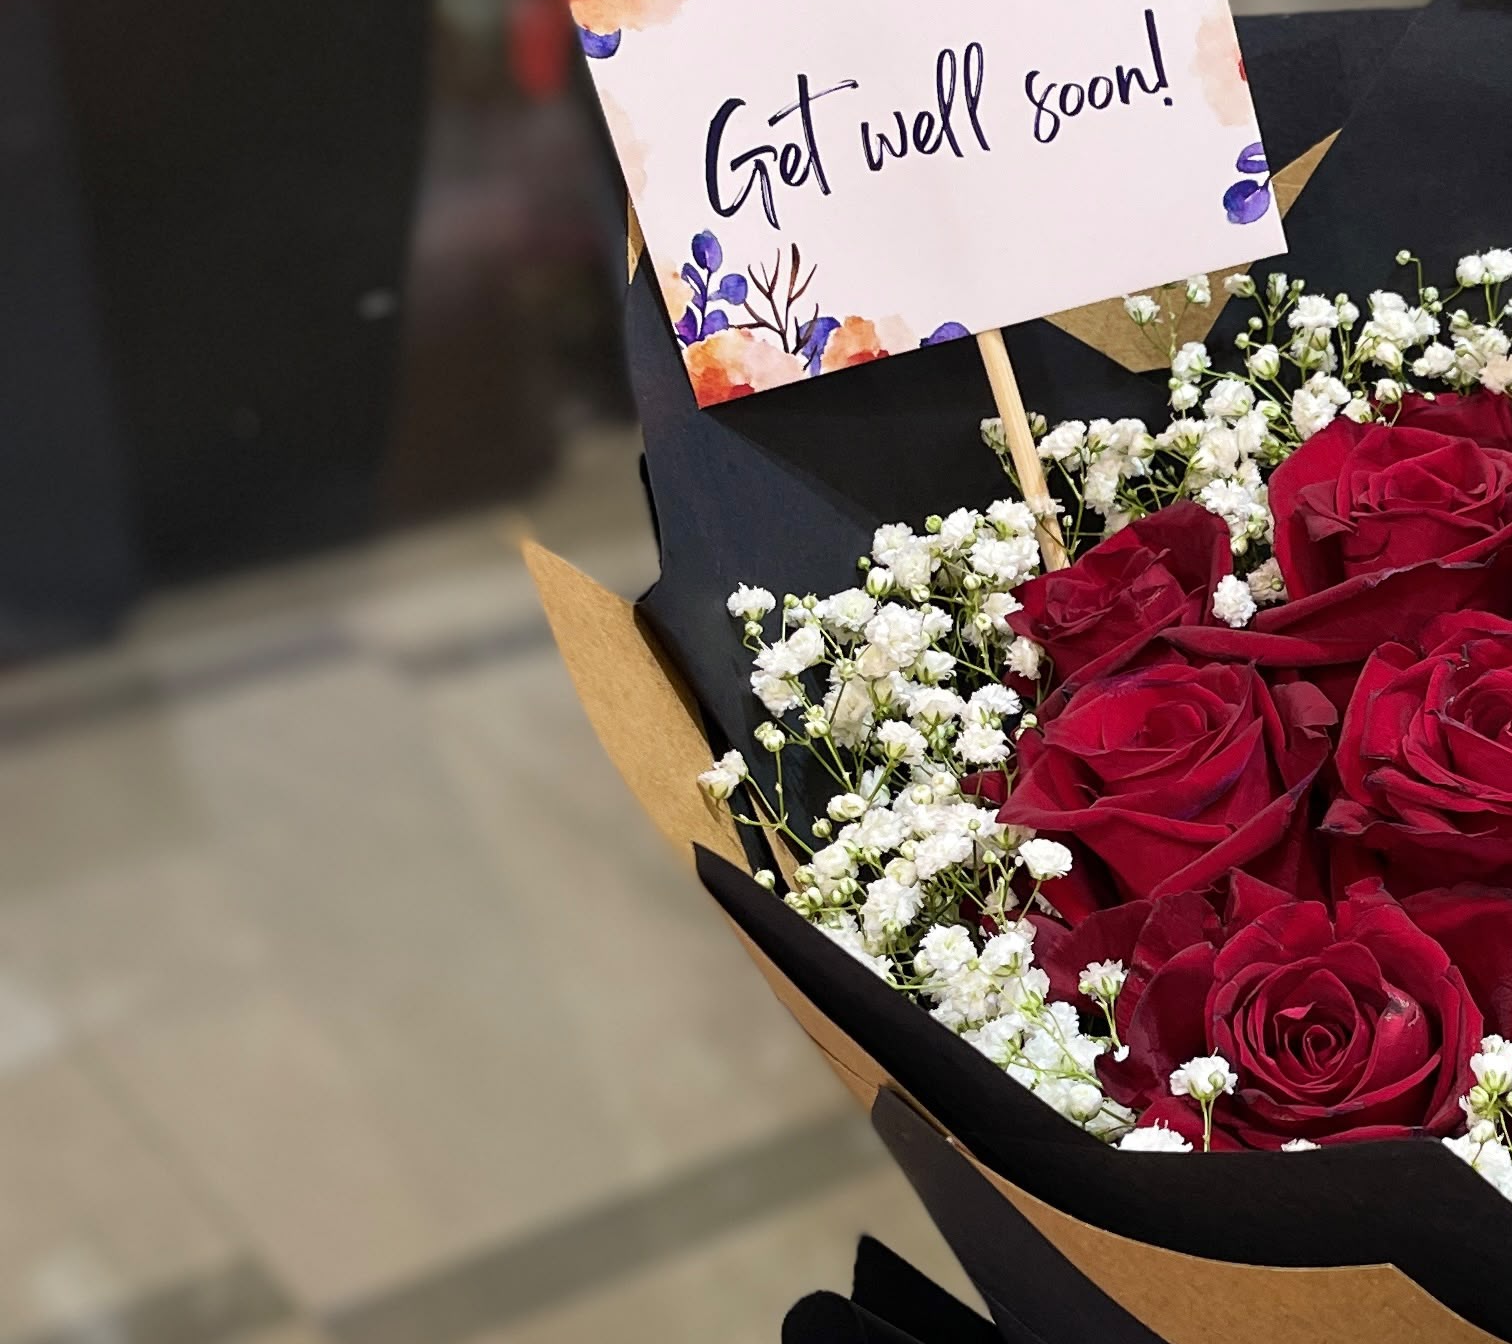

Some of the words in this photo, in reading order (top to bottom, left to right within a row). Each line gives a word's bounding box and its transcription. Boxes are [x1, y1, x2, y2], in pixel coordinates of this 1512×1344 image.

[706, 74, 858, 230] Get
[861, 42, 990, 171] well
[1025, 9, 1172, 143] soon!
